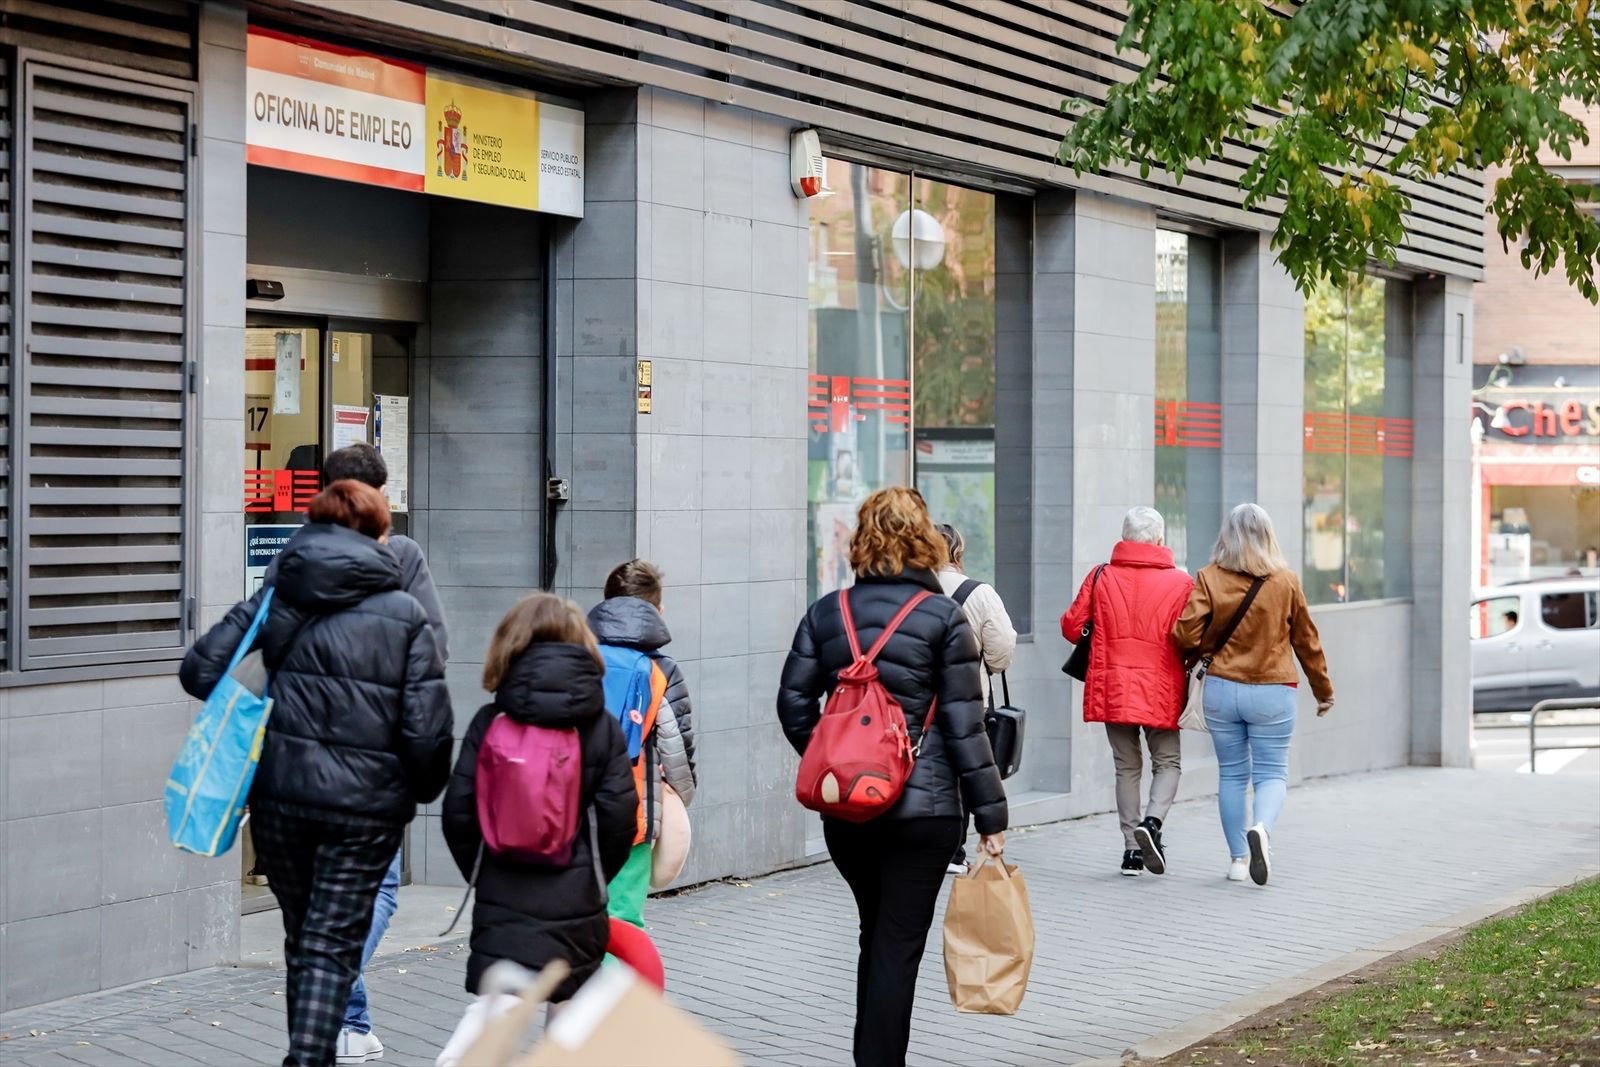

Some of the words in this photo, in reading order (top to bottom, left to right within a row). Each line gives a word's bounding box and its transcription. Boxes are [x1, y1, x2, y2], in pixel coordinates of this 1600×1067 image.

[254, 91, 320, 132] OFICINA
[324, 105, 345, 137] DE
[350, 111, 412, 150] EMPLEO
[472, 133, 503, 149] MINISTERIO
[472, 147, 481, 160] DE
[481, 149, 502, 163] EMPLEO
[472, 162, 477, 173] Y
[477, 162, 508, 179] SEGURIDAD
[508, 168, 527, 183] SOCIAL
[247, 406, 269, 432] 17
